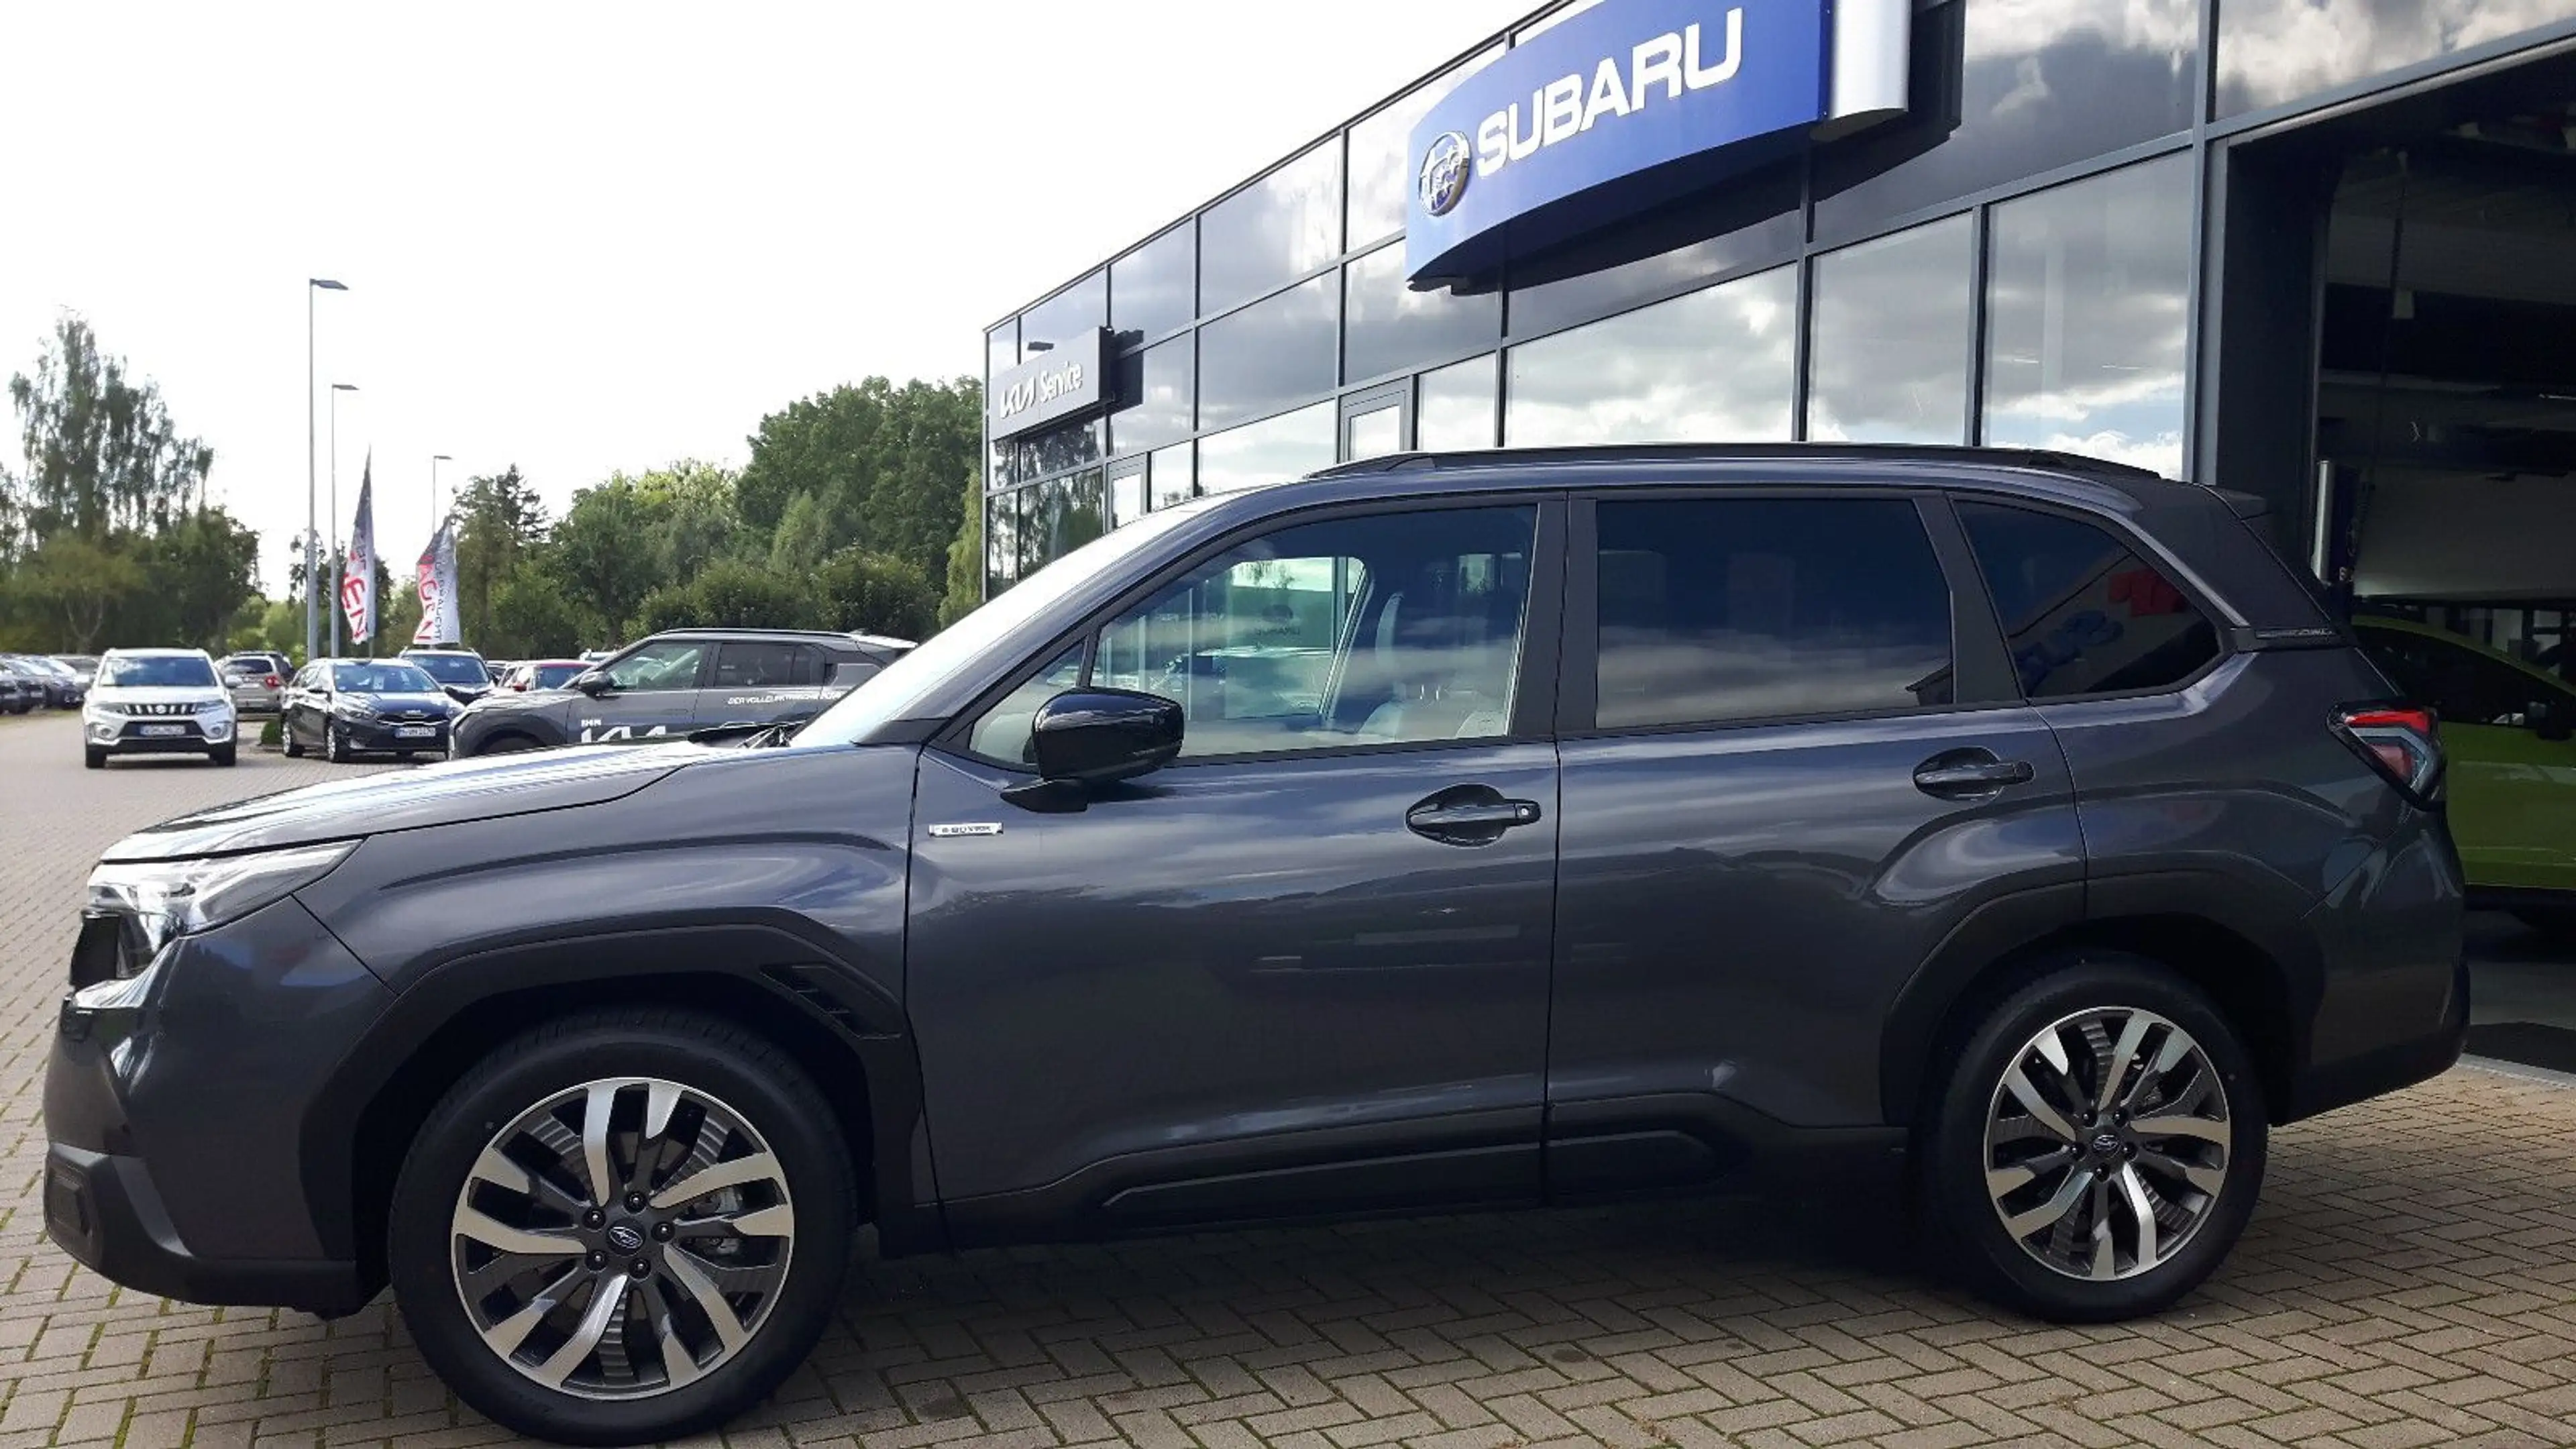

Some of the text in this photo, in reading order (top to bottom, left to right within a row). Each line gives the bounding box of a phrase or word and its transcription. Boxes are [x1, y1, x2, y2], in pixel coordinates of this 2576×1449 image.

[1477, 7, 1743, 178] SUBARU
[1000, 361, 1083, 419] KIA Service
